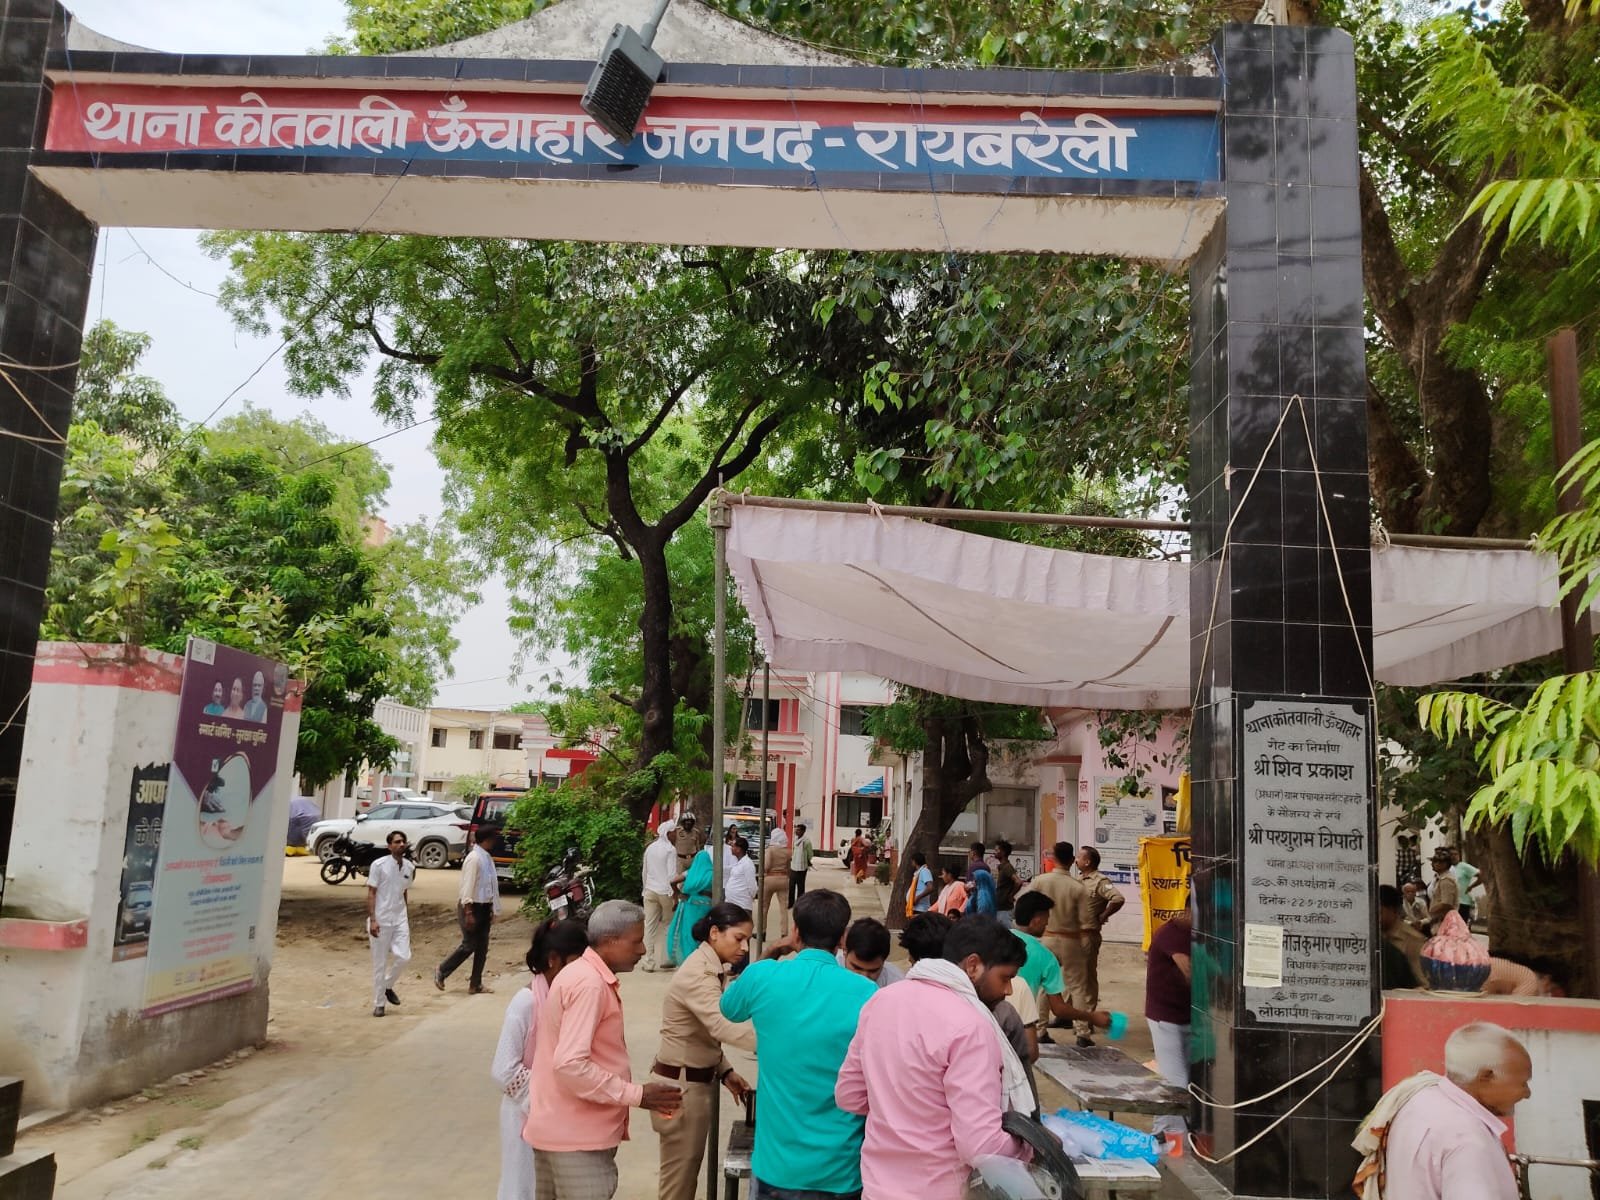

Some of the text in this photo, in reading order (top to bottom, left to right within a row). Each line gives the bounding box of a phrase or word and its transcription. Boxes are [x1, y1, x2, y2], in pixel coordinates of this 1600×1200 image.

[83, 100, 209, 146] थाना
[214, 92, 416, 155] कोतवाली
[642, 115, 821, 172] जनपद
[852, 111, 1136, 174] रायबरेली
[1245, 713, 1273, 734] थाना
[1267, 737, 1341, 753] गेट का निर्माण
[1254, 754, 1355, 781] श्री शिव प्रकाश
[1248, 823, 1364, 852] श्री परशुराम त्रिपाठी
[1302, 934, 1332, 957] कुमार
[1334, 932, 1367, 954] पाण्डेय
[1258, 1002, 1310, 1018] लोकार्पण
